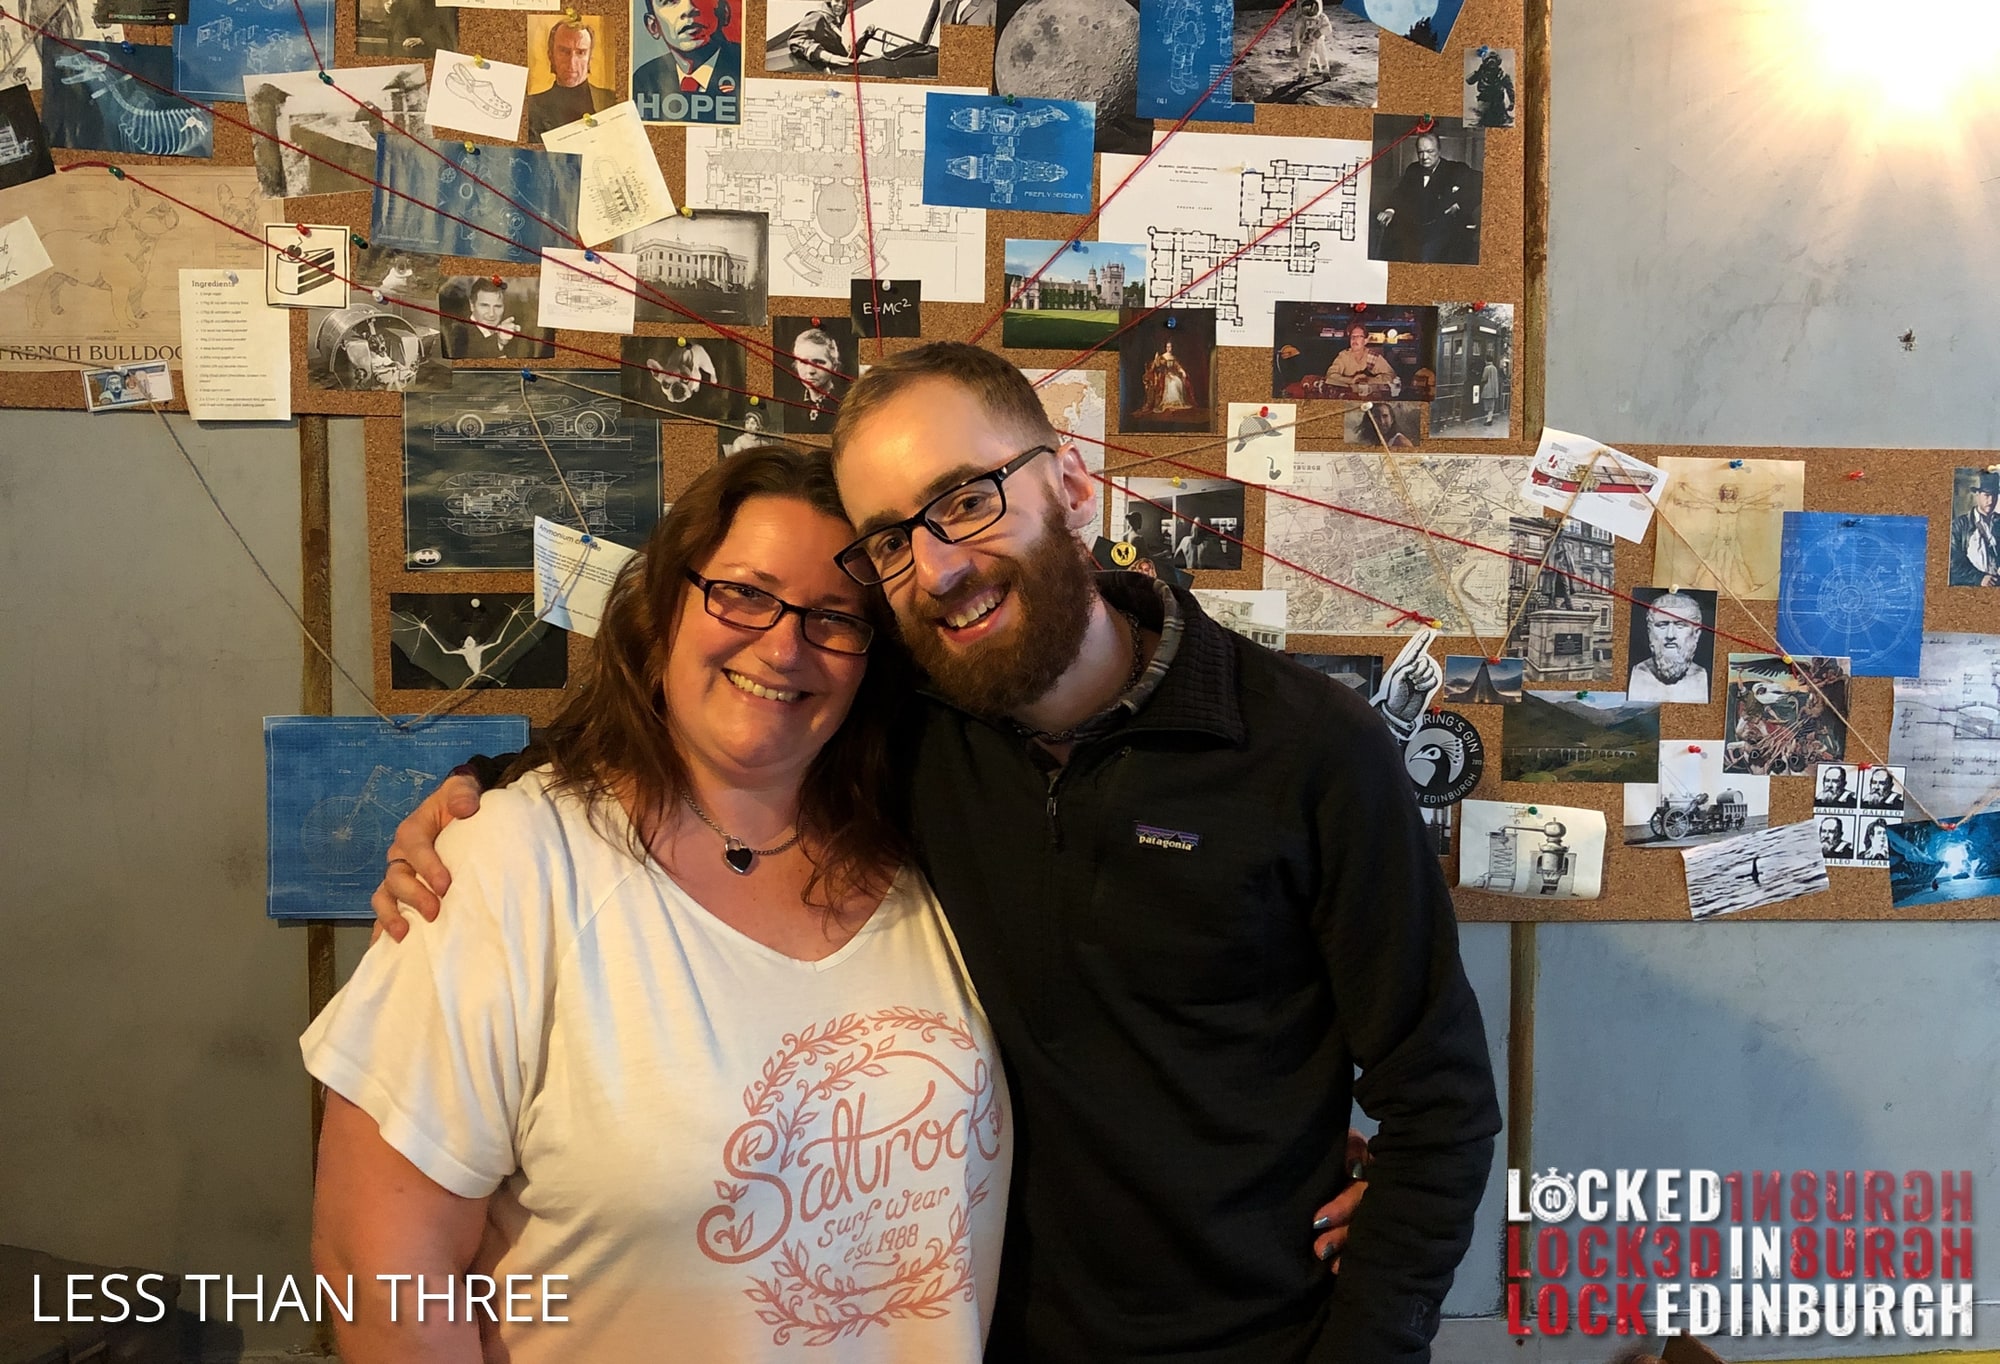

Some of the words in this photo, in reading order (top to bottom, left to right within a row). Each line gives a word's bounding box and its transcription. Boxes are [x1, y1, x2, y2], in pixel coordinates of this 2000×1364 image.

[637, 92, 737, 122] HOPE
[539, 523, 574, 543] Ammonium
[1423, 713, 1465, 732] RING'S
[1463, 731, 1480, 753] GIN
[1423, 772, 1477, 803] EDINBURGH
[1138, 835, 1194, 851] patagonia
[697, 1057, 1001, 1264] Saltrock
[843, 1233, 873, 1263] est
[876, 1223, 919, 1253] 1988
